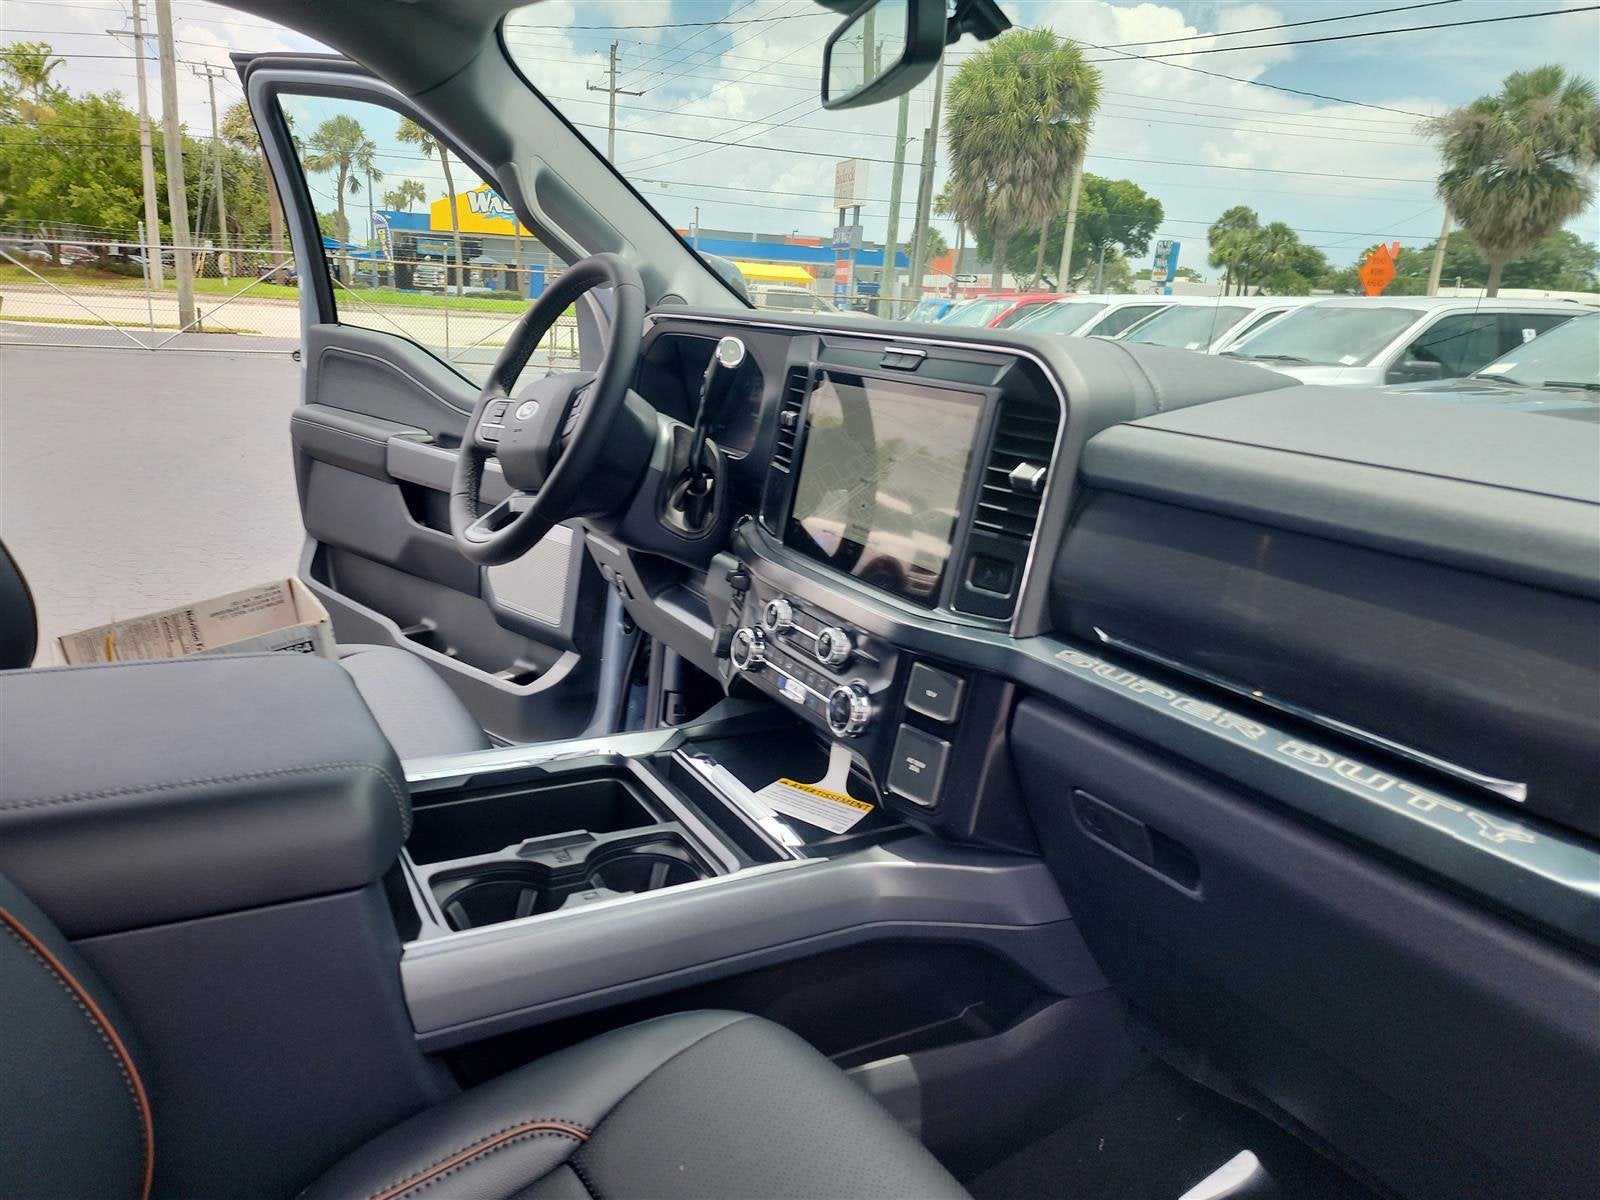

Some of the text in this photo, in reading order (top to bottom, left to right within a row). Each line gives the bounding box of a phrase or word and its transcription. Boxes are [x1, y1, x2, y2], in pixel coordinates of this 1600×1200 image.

[791, 783, 872, 811] AVERTISSEMENT
[1054, 649, 1535, 844] SUPER DUTY
